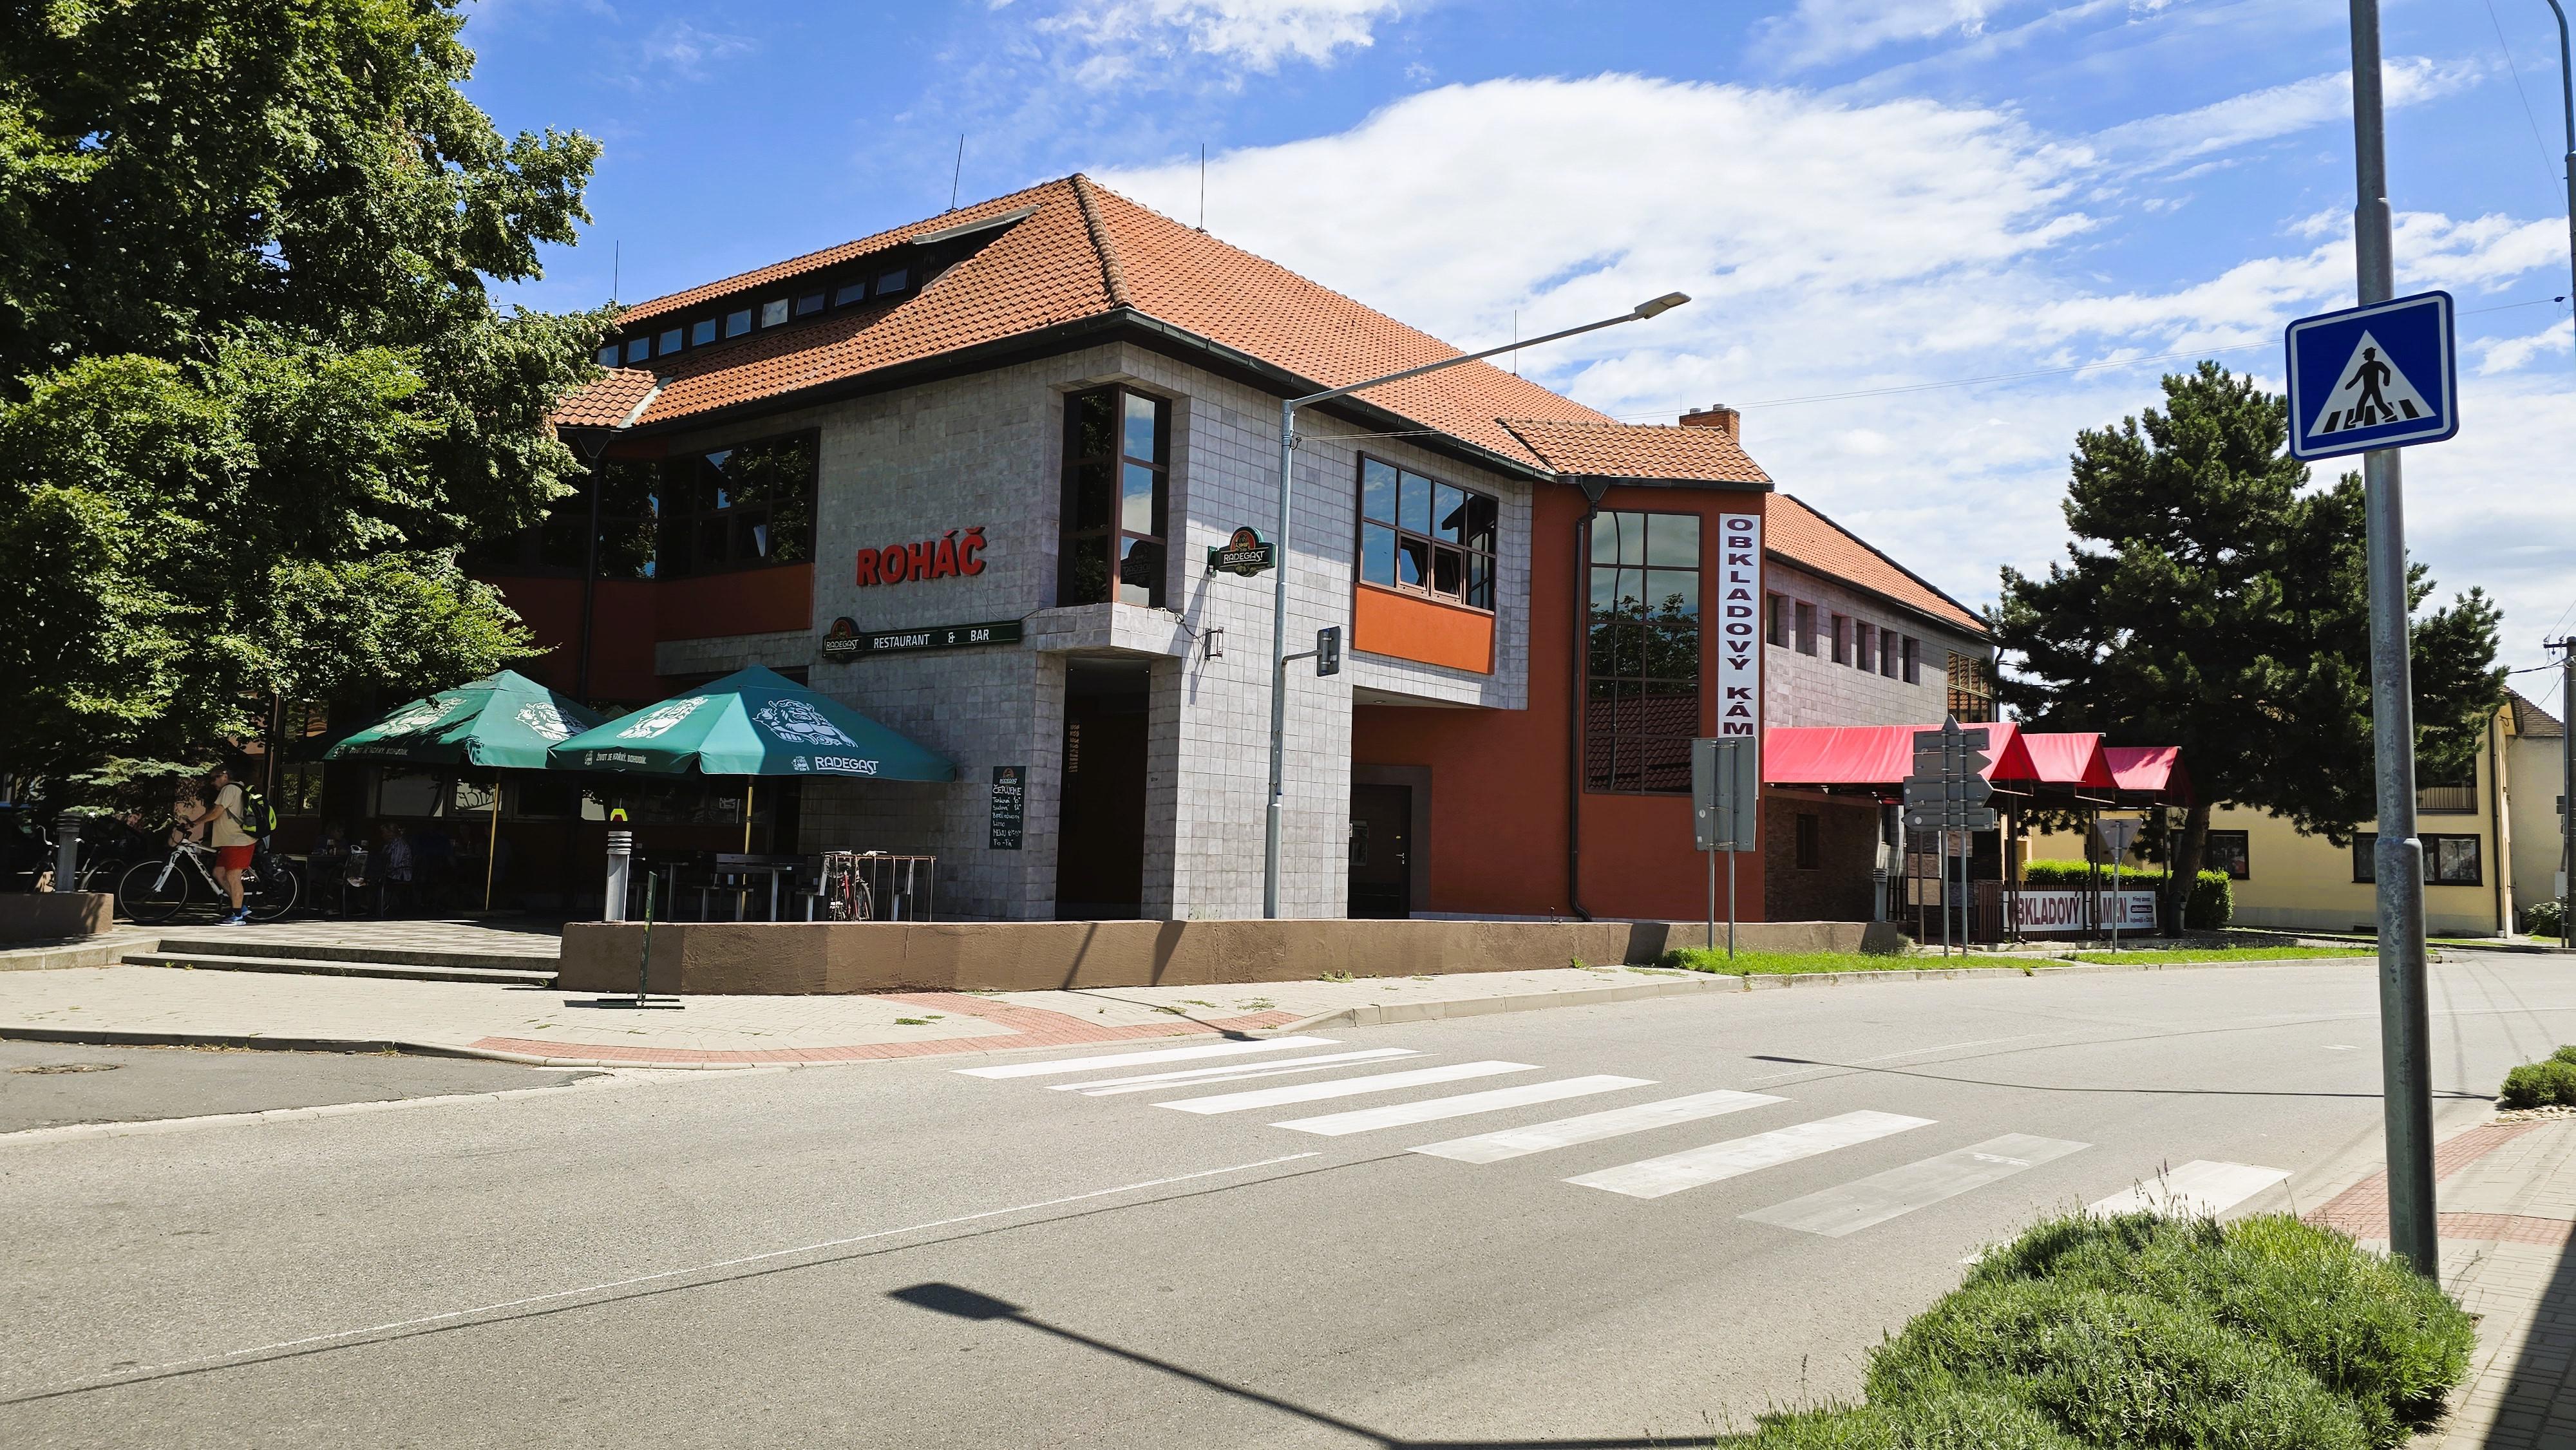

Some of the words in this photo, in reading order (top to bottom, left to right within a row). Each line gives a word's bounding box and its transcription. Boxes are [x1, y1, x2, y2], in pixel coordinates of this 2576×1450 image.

[857, 527, 987, 587] ROHÁČ
[1224, 550, 1265, 564] RADEGAST
[1726, 518, 1754, 670] OBKLADOVÝ
[826, 639, 858, 651] RADEGAST
[874, 634, 931, 649] RESTAURANT
[948, 632, 955, 643] &
[971, 629, 989, 641] BAR
[1723, 686, 1754, 735] KÁM
[815, 757, 878, 775] RADEGAST
